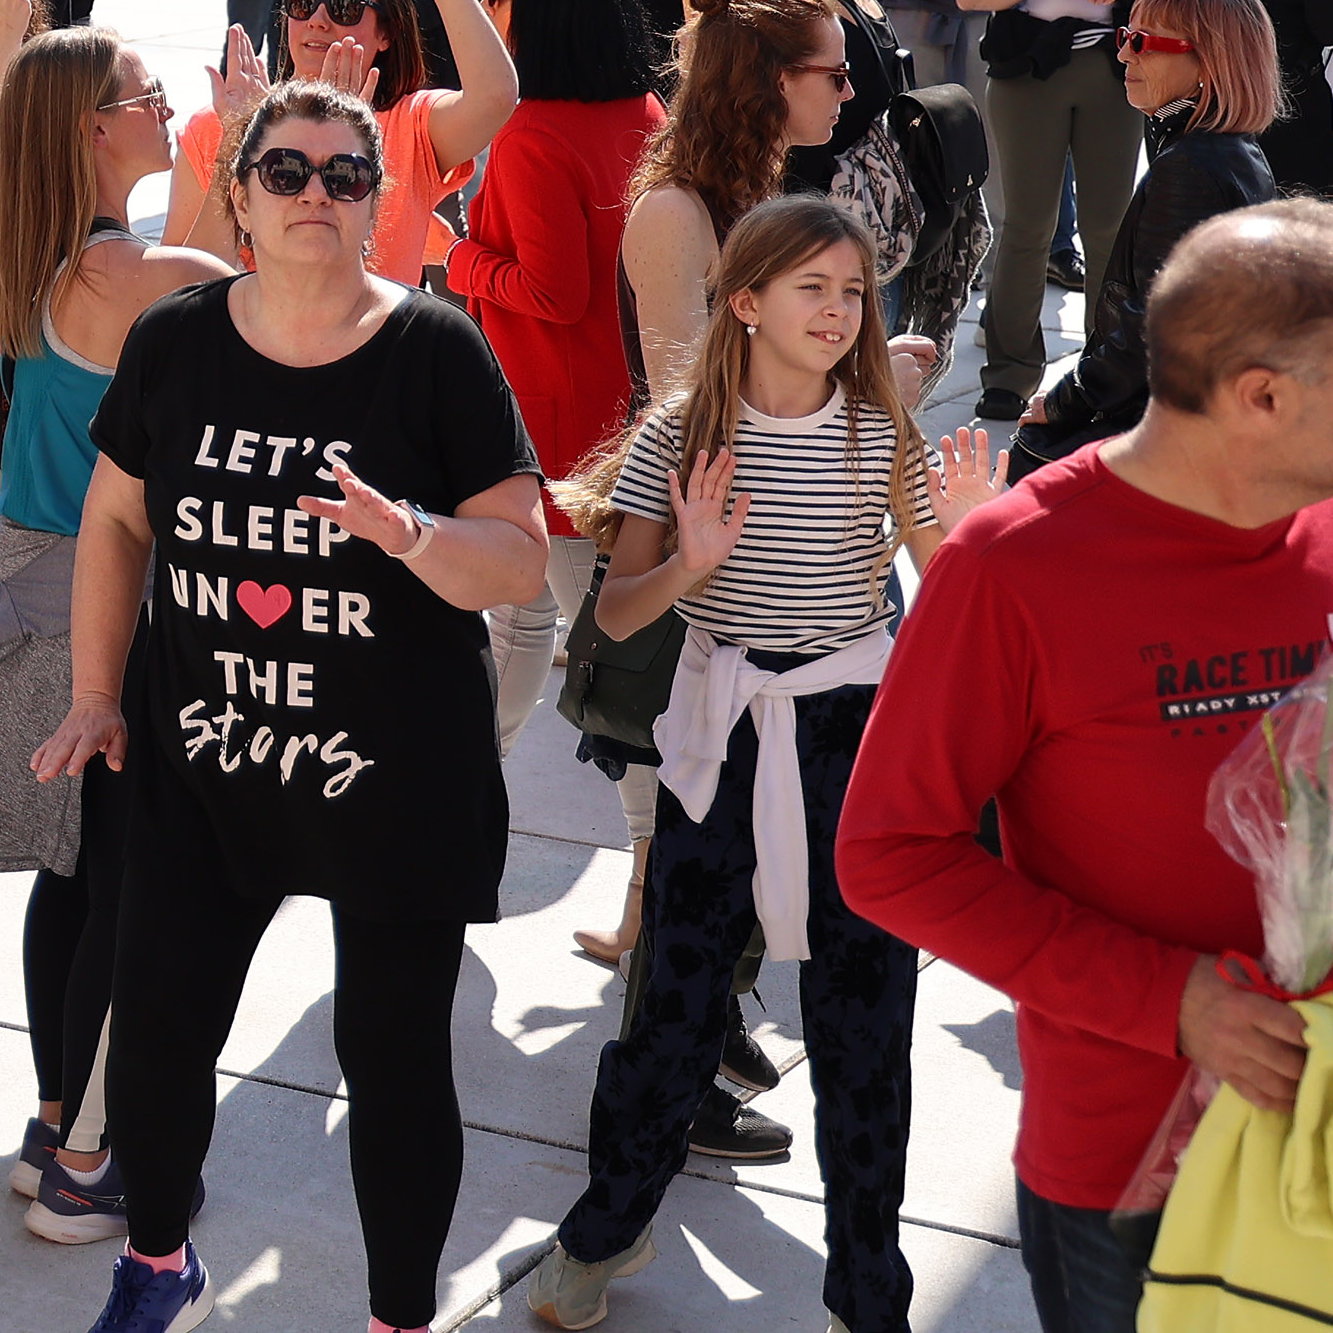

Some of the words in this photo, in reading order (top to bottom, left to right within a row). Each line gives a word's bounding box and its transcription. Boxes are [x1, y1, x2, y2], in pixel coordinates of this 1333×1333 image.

[194, 425, 353, 482] LET'S
[174, 496, 351, 557] SLEEP
[214, 651, 314, 708] THE
[1157, 651, 1250, 697] RACE
[1259, 640, 1325, 682] TIM
